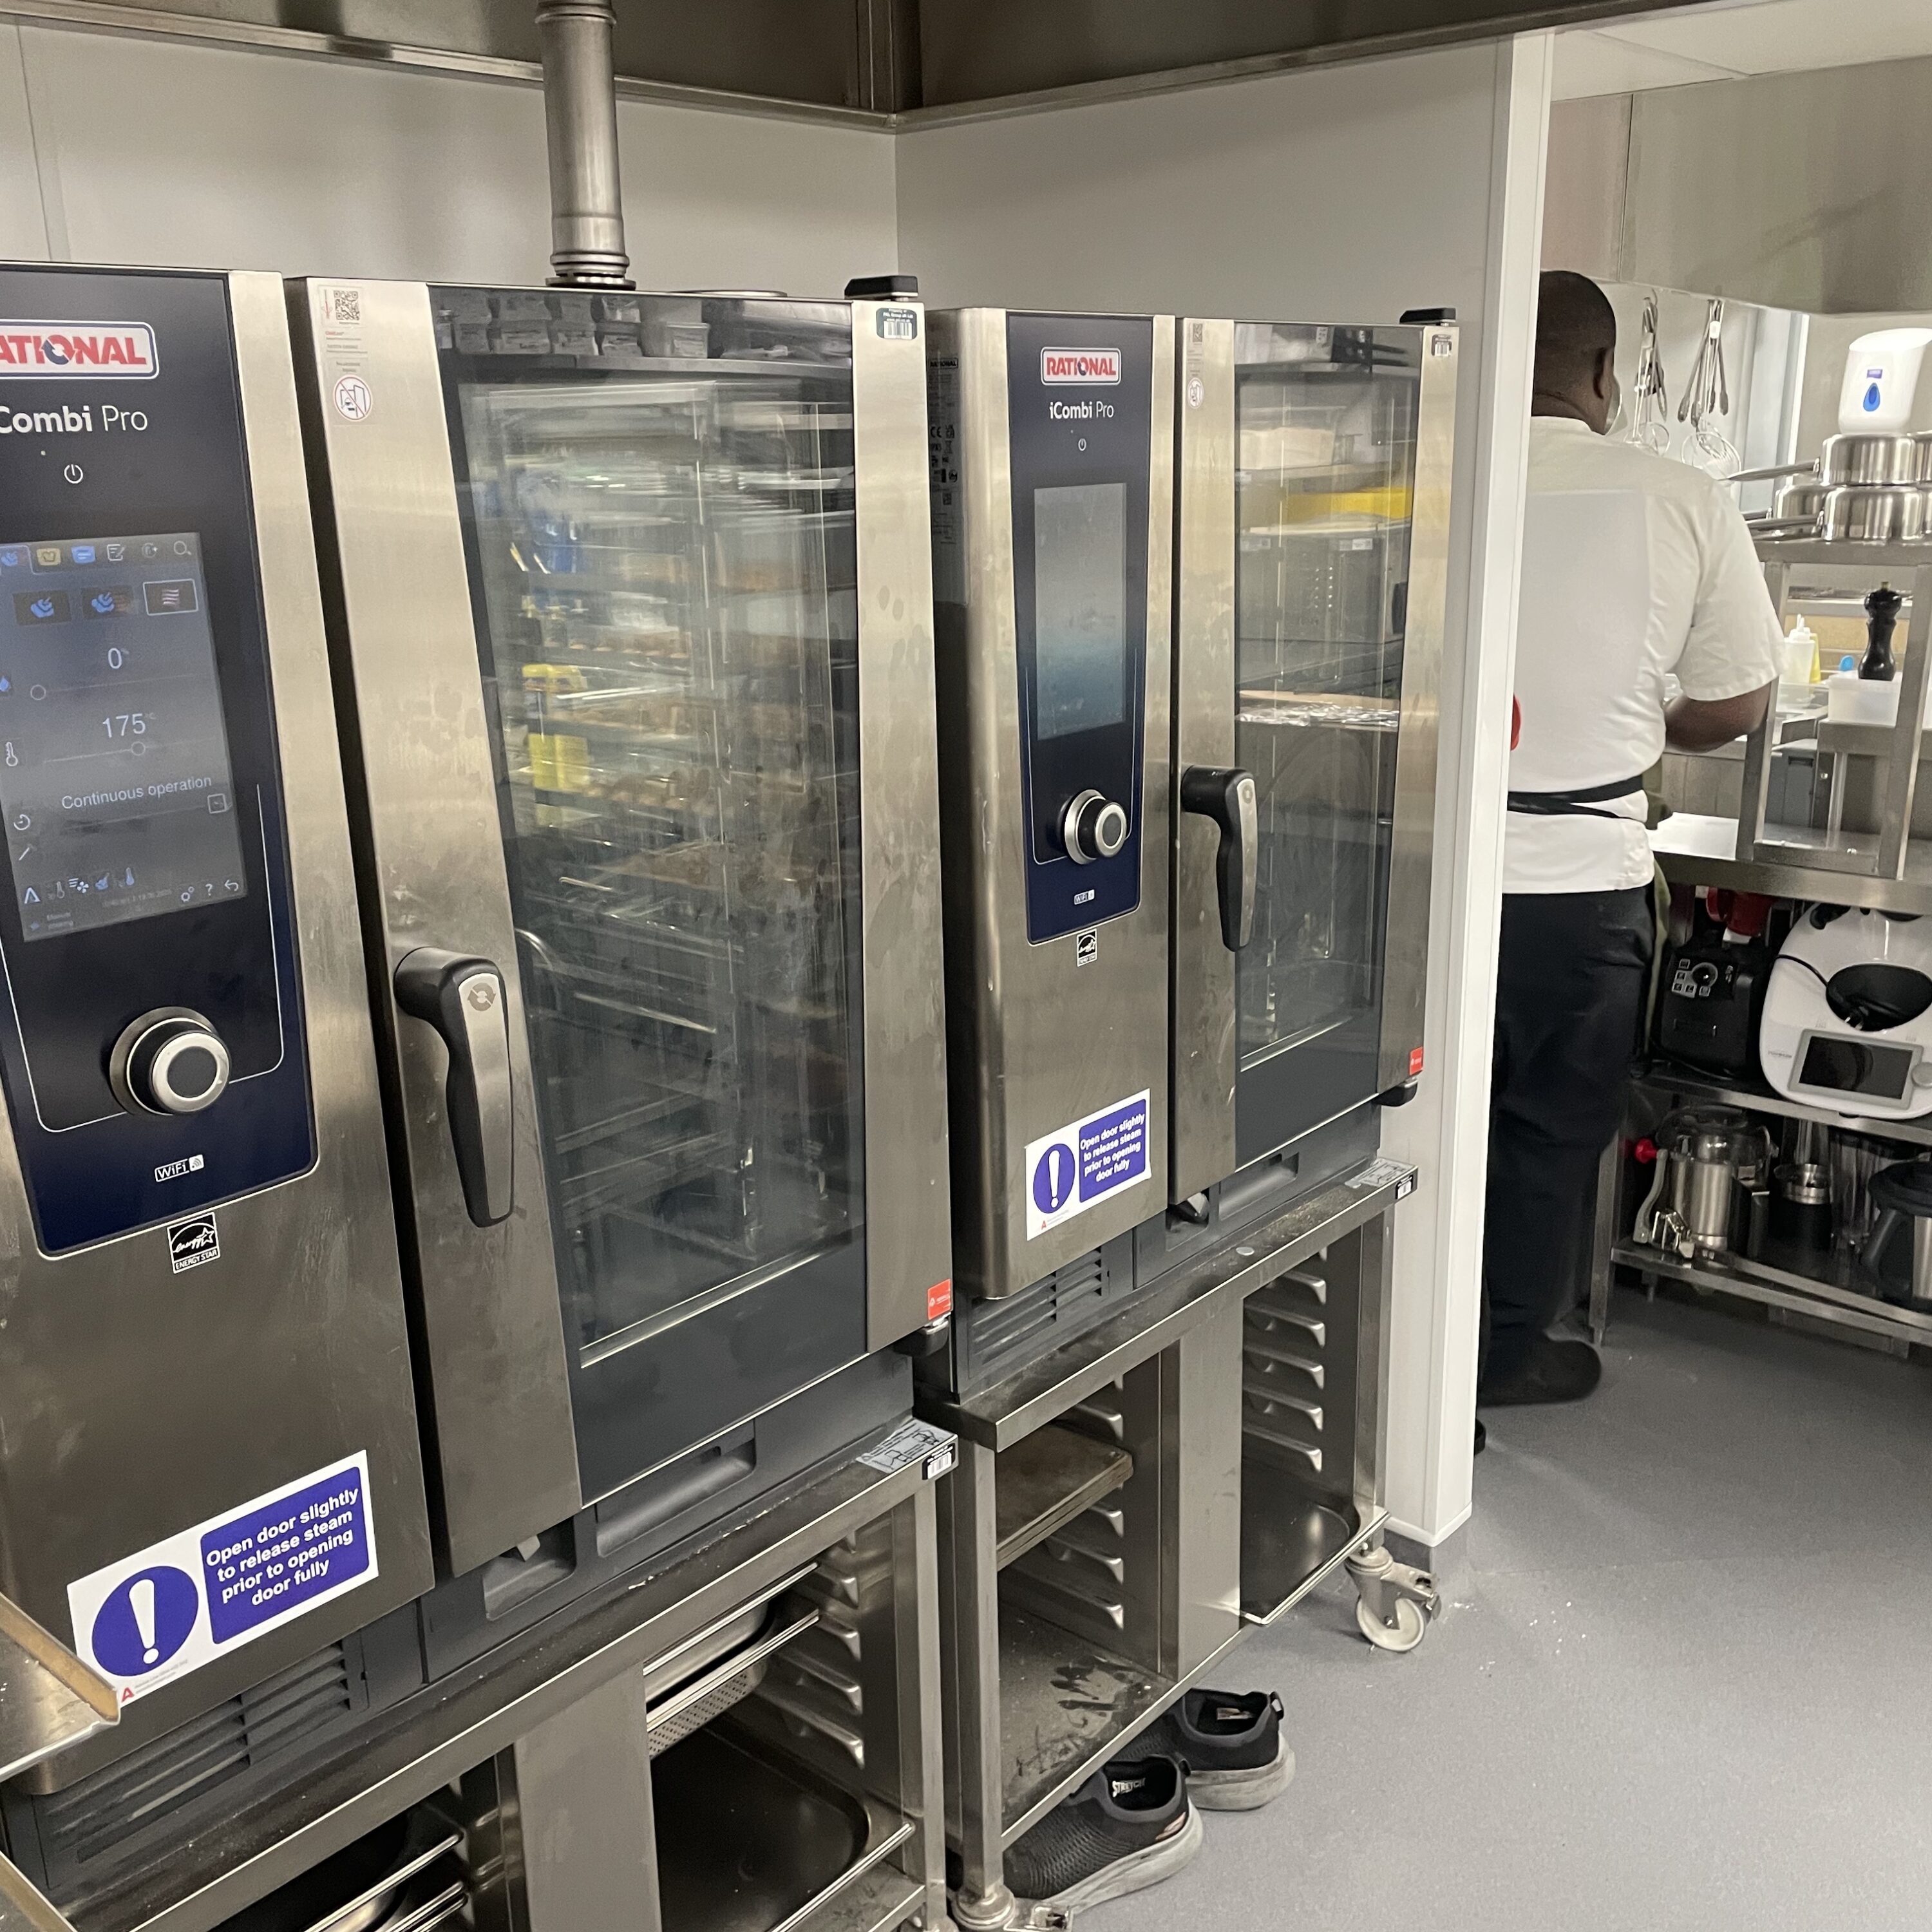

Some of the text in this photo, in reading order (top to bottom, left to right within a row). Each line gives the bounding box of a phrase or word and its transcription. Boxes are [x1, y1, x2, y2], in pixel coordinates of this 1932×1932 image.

[1046, 357, 1117, 376] RATIONAL
[102, 405, 148, 431] Pro
[1049, 401, 1114, 419] iCombi Pro
[108, 647, 123, 669] 0
[102, 713, 146, 738] 175
[62, 776, 212, 810] Continuous operation
[1080, 1113, 1145, 1150] Open door slightly
[1083, 1128, 1142, 1162] to release steam
[157, 1162, 187, 1179] WiFi
[1084, 1141, 1141, 1177] prior to opening
[1096, 1159, 1130, 1182] door fully
[175, 1249, 218, 1270] ENERGY STAR
[206, 1488, 359, 1566] Open door slightly
[217, 1511, 353, 1582] to release steam
[222, 1529, 354, 1604] prior to opening
[252, 1559, 330, 1605] door fully
